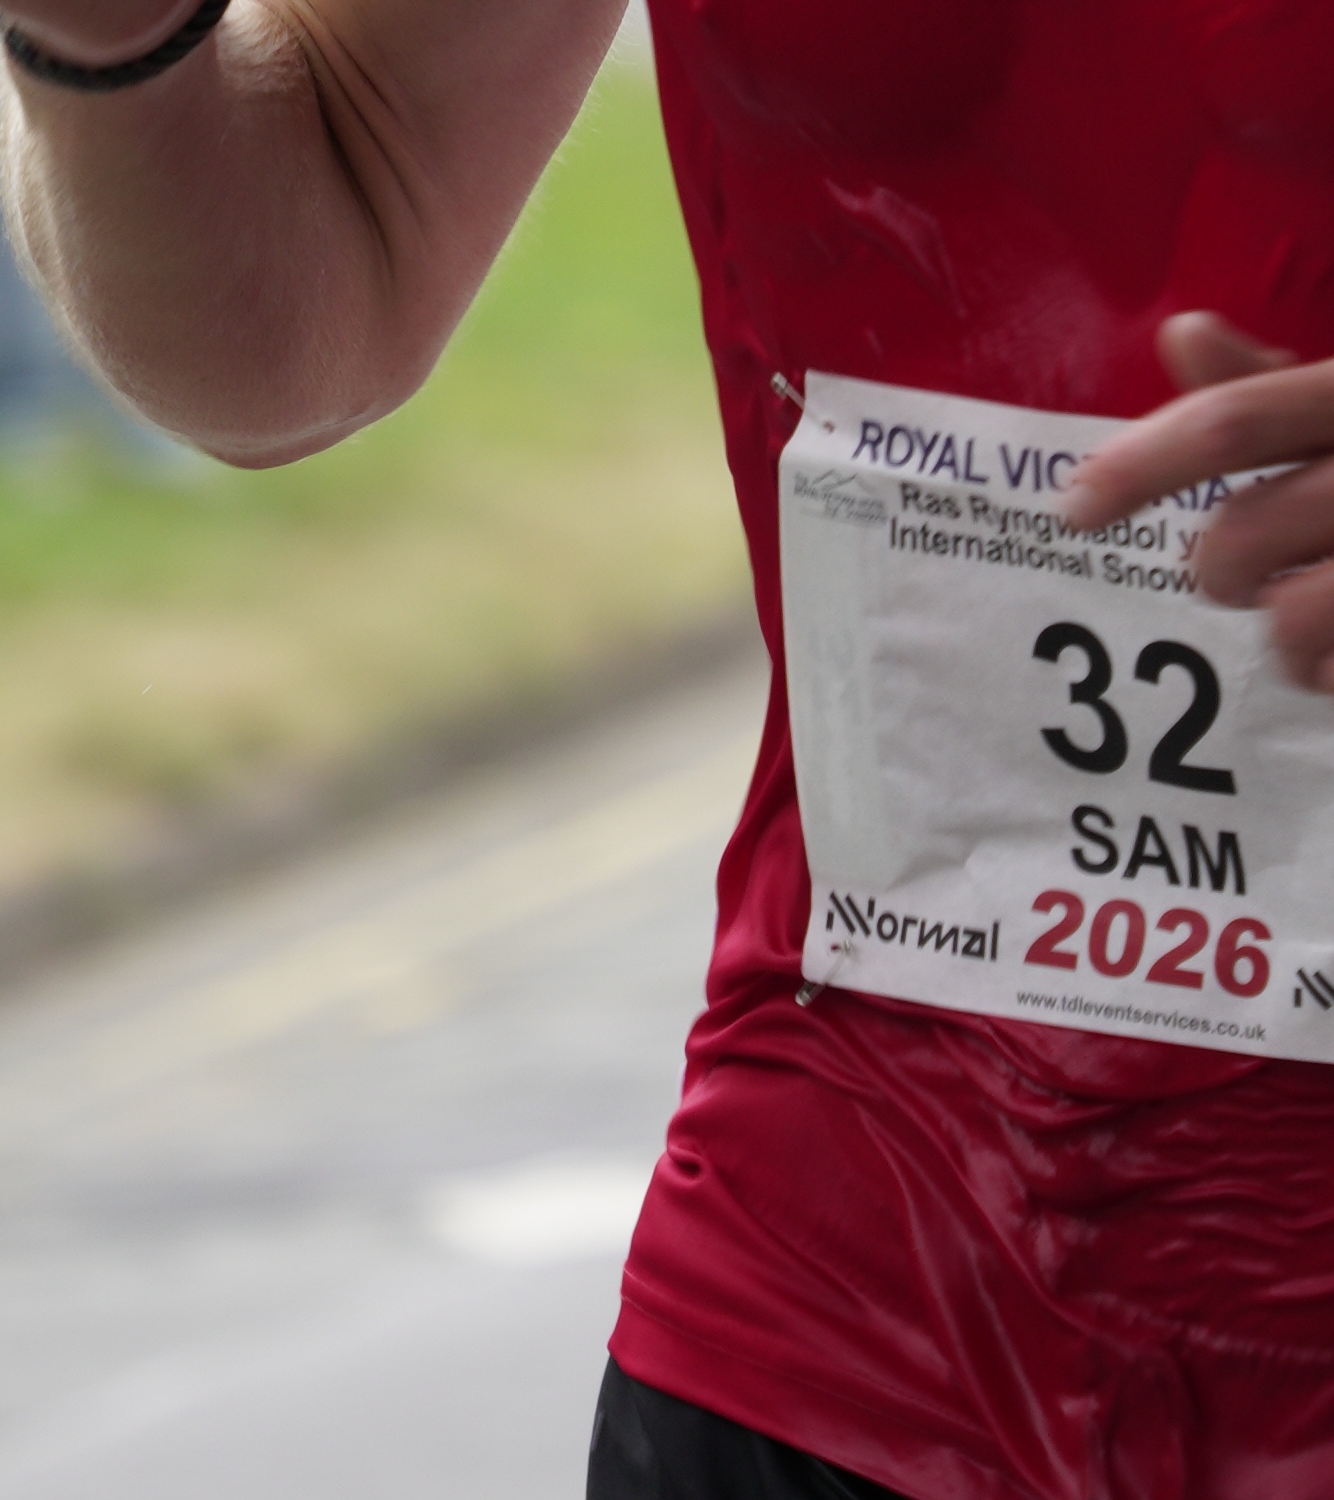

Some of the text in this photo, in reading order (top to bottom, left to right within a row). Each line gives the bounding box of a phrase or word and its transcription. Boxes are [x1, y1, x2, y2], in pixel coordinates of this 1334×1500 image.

[851, 419, 1233, 512] ROYAL VICIA
[889, 515, 1203, 596] International Snow
[899, 480, 963, 520] Ras
[968, 493, 1167, 553] Ryngwadol
[1176, 527, 1208, 562] y
[1032, 621, 1237, 795] 32
[1069, 804, 1246, 896] SAM
[1023, 887, 1274, 999] 2026
[1016, 990, 1267, 1042] www.tdleventservices.co.uk
